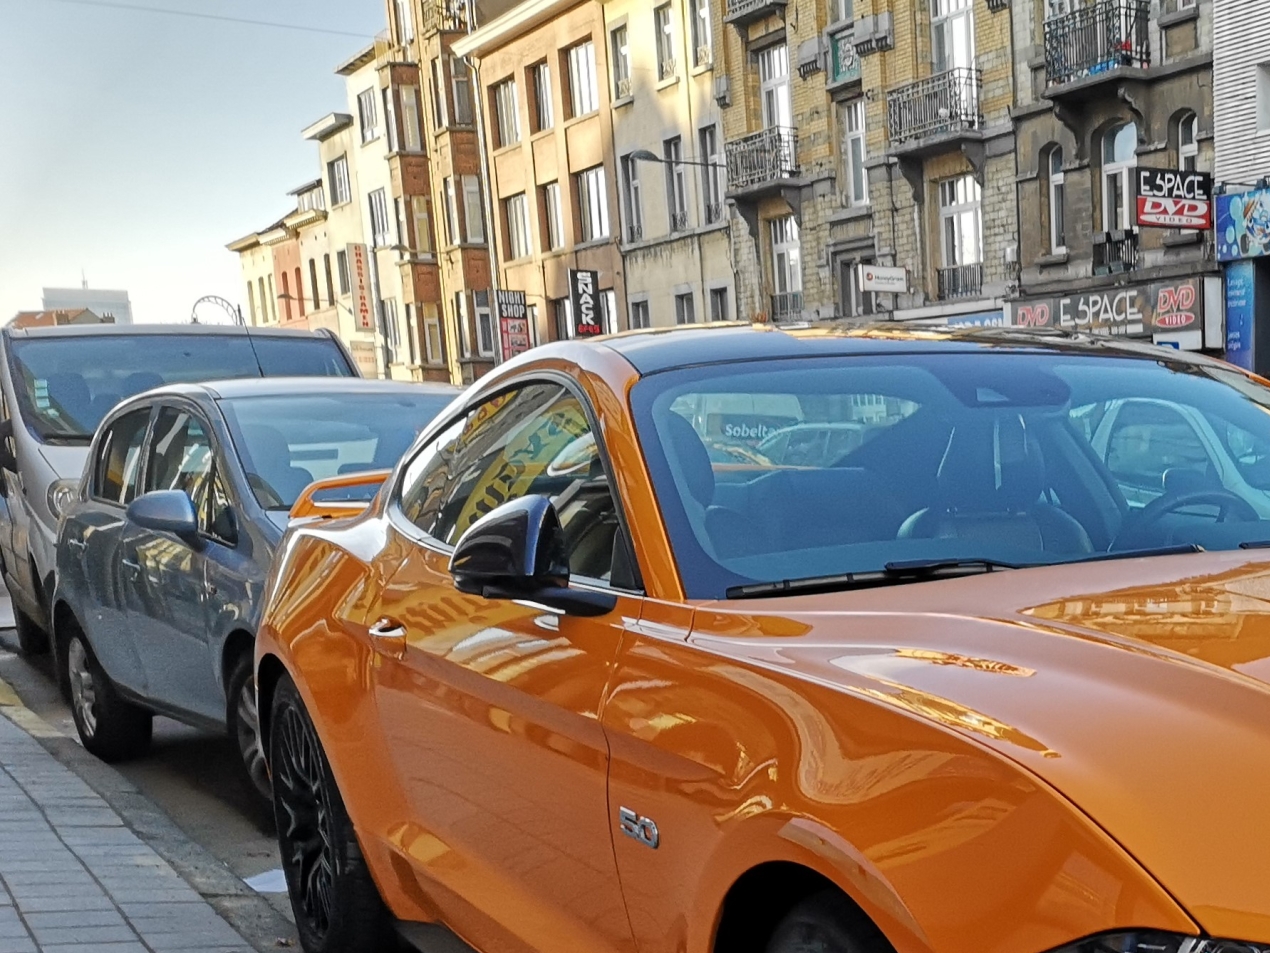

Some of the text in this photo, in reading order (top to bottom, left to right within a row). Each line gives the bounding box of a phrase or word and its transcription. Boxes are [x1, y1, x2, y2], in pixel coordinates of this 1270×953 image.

[1140, 171, 1208, 200] ESPACE
[1143, 197, 1208, 217] DVD
[1155, 215, 1193, 224] VIDEO
[498, 290, 525, 304] NIGHT
[576, 271, 595, 325] SNACK
[1157, 285, 1196, 313] DVD
[501, 304, 526, 318] SHOP
[1017, 303, 1050, 327] DVD
[1059, 290, 1143, 327] ESPACE
[1165, 314, 1187, 326] VIDEO
